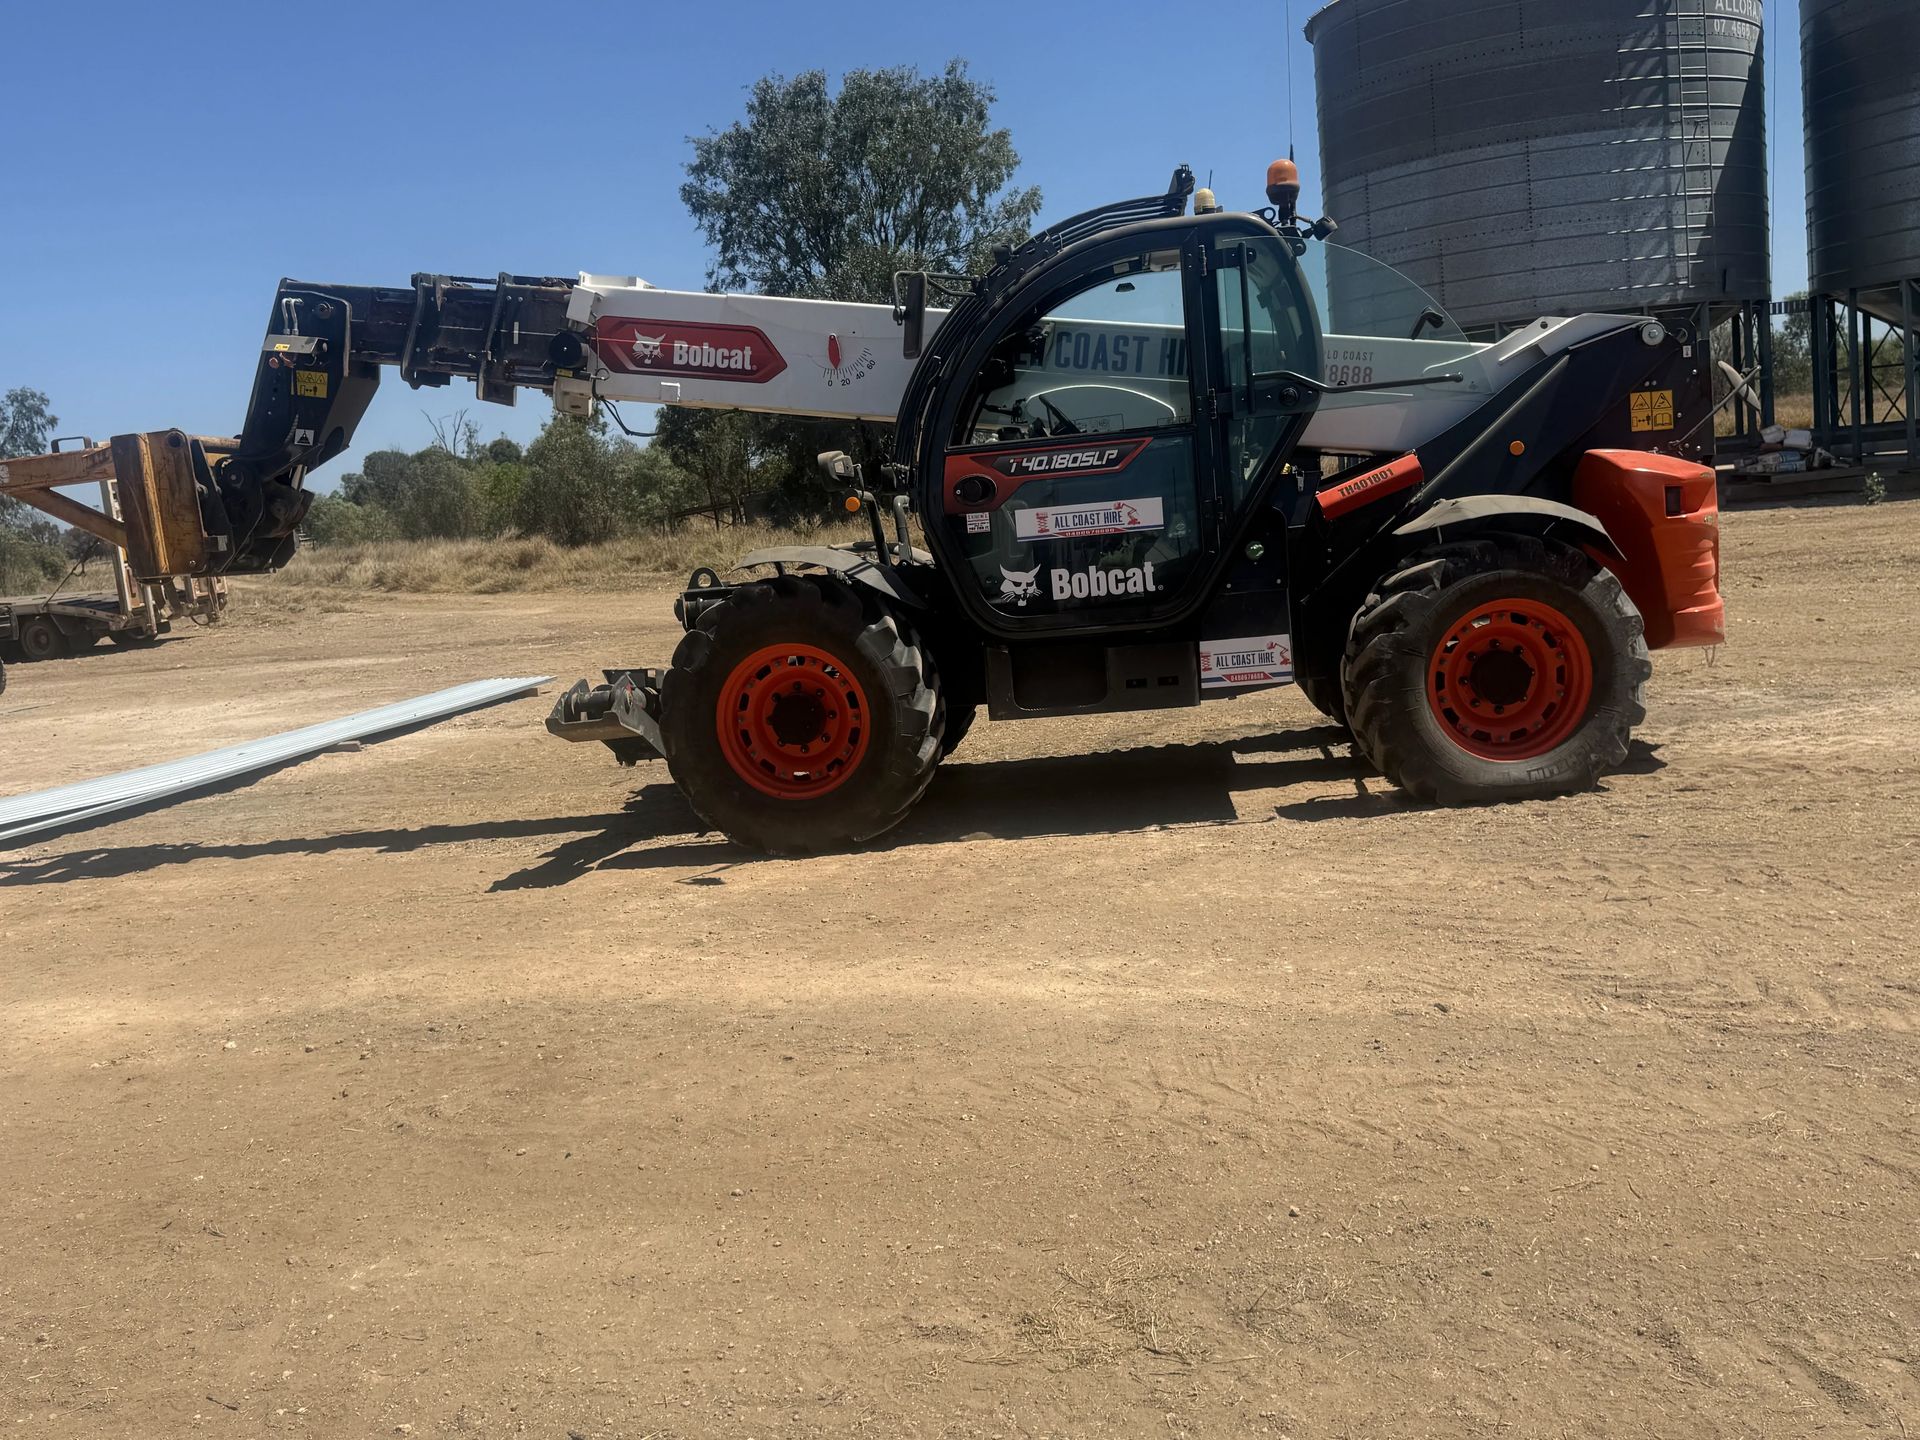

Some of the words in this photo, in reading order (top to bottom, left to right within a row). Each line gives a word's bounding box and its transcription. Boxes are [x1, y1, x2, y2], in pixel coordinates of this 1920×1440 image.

[1714, 19, 1726, 33] 07
[673, 340, 752, 370] Bobcat
[1055, 331, 1150, 373] COAST
[1158, 337, 1188, 376] HI
[1343, 350, 1374, 361] COAST
[840, 378, 851, 387] 20
[856, 370, 865, 380] 40
[866, 359, 876, 370] 60
[1326, 364, 1373, 384] 8688
[1009, 449, 1118, 473] T40.180SLP
[1337, 468, 1395, 498] TH401801
[1054, 516, 1070, 529] ALL
[1073, 513, 1100, 527] COAST
[1103, 511, 1123, 524] HIRE
[1050, 561, 1156, 601] Bobcat
[1216, 655, 1230, 668] ALL
[1231, 653, 1256, 666] COAST
[1258, 652, 1274, 663] HIRE
